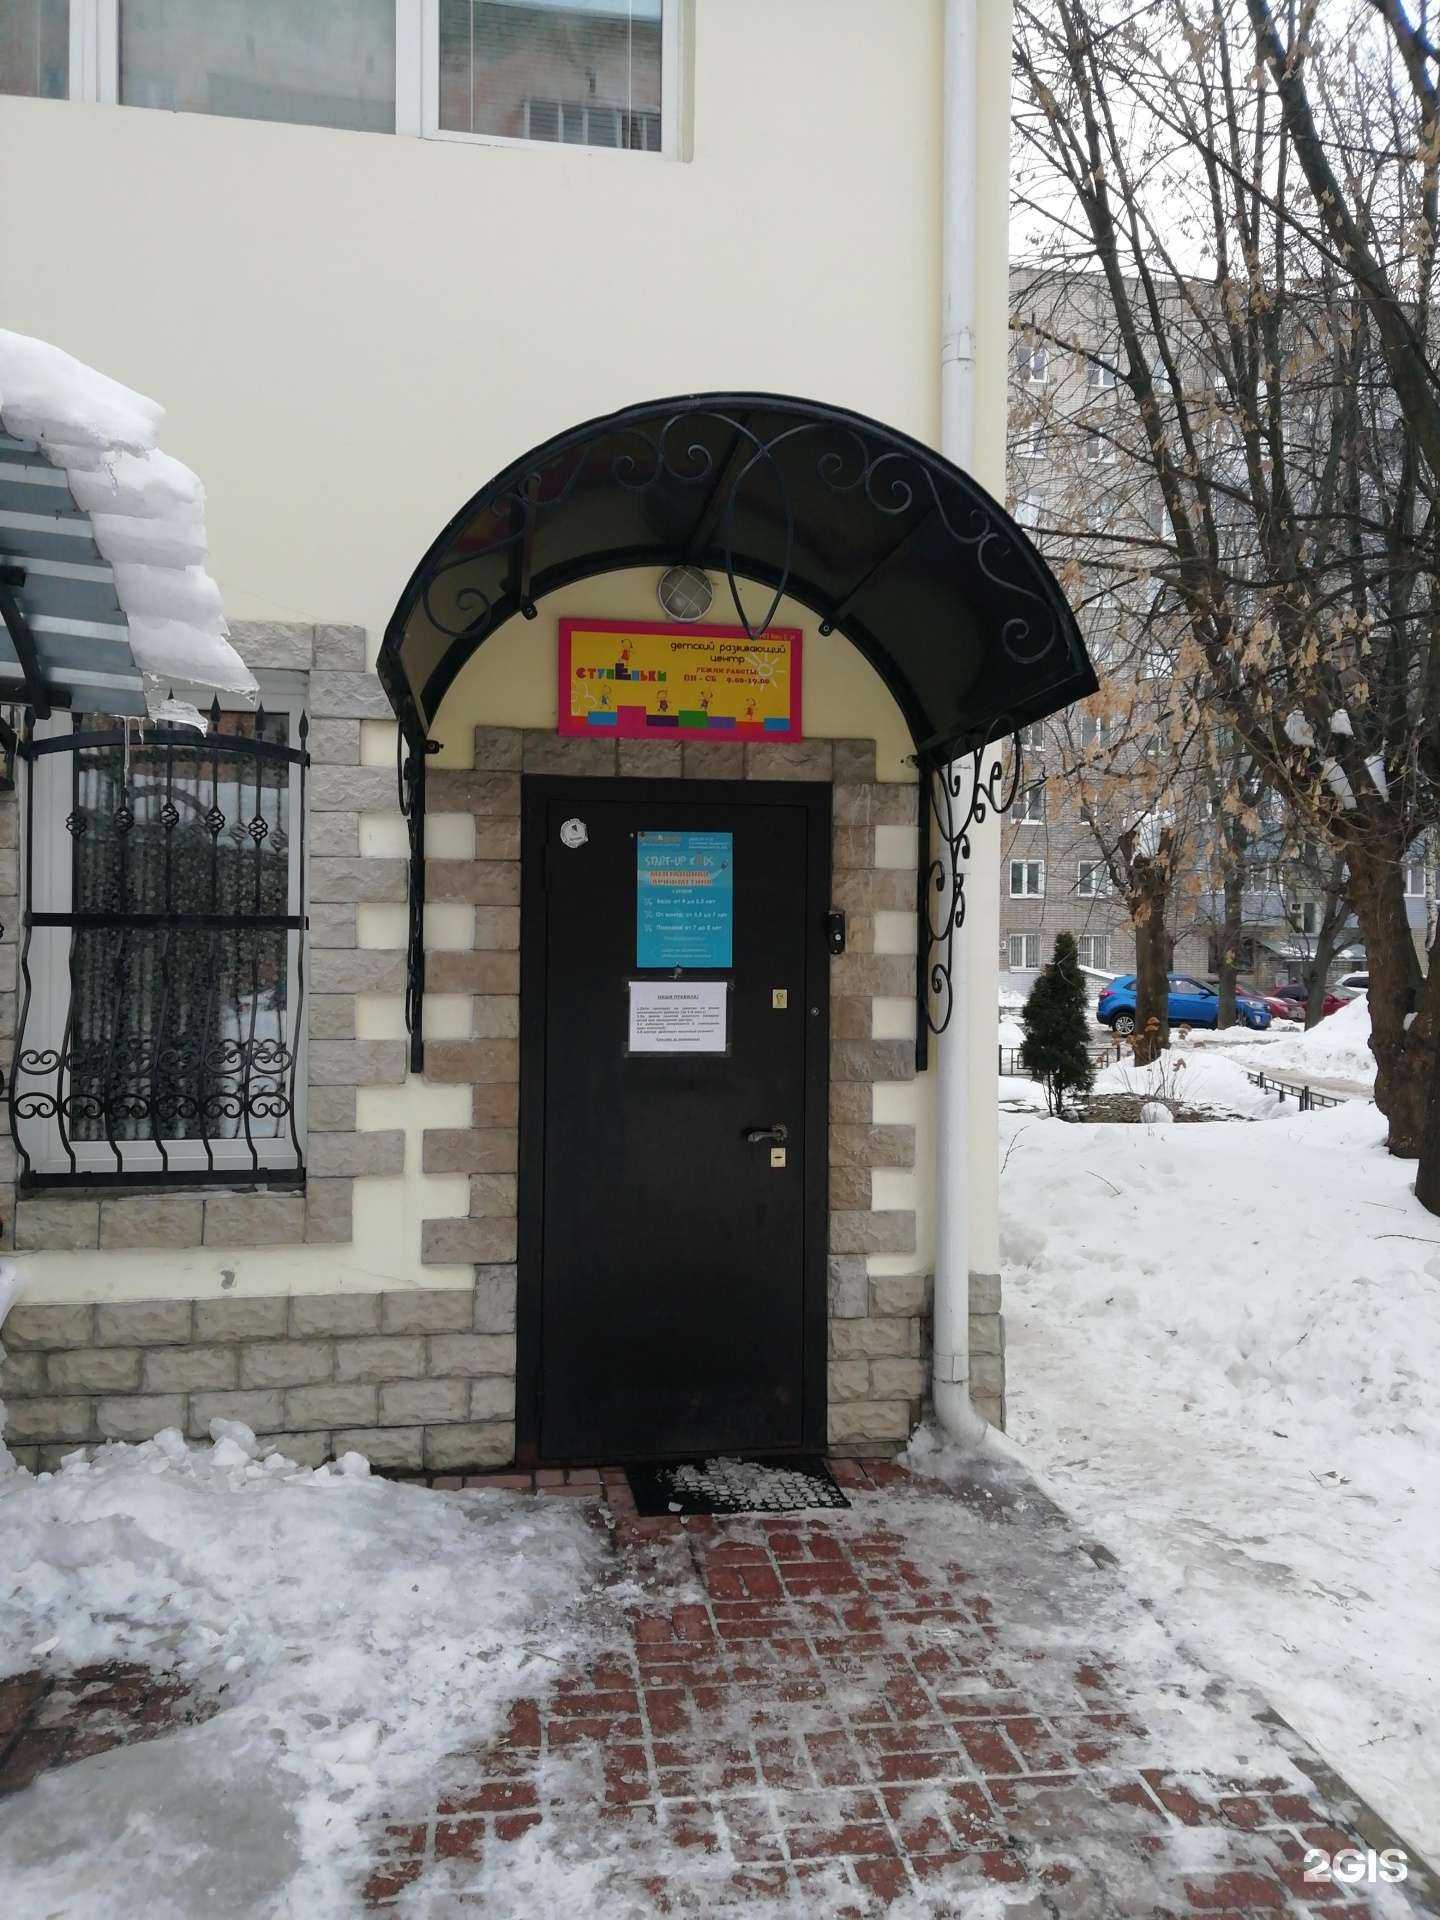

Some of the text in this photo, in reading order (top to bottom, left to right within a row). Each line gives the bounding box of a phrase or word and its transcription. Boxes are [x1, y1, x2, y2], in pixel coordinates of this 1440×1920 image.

[670, 640, 786, 654] детский развивающий
[710, 654, 746, 665] центр
[576, 662, 667, 682] СТУПЕНЬКИ
[683, 674, 697, 682] ПН
[644, 855, 687, 866] START-UP
